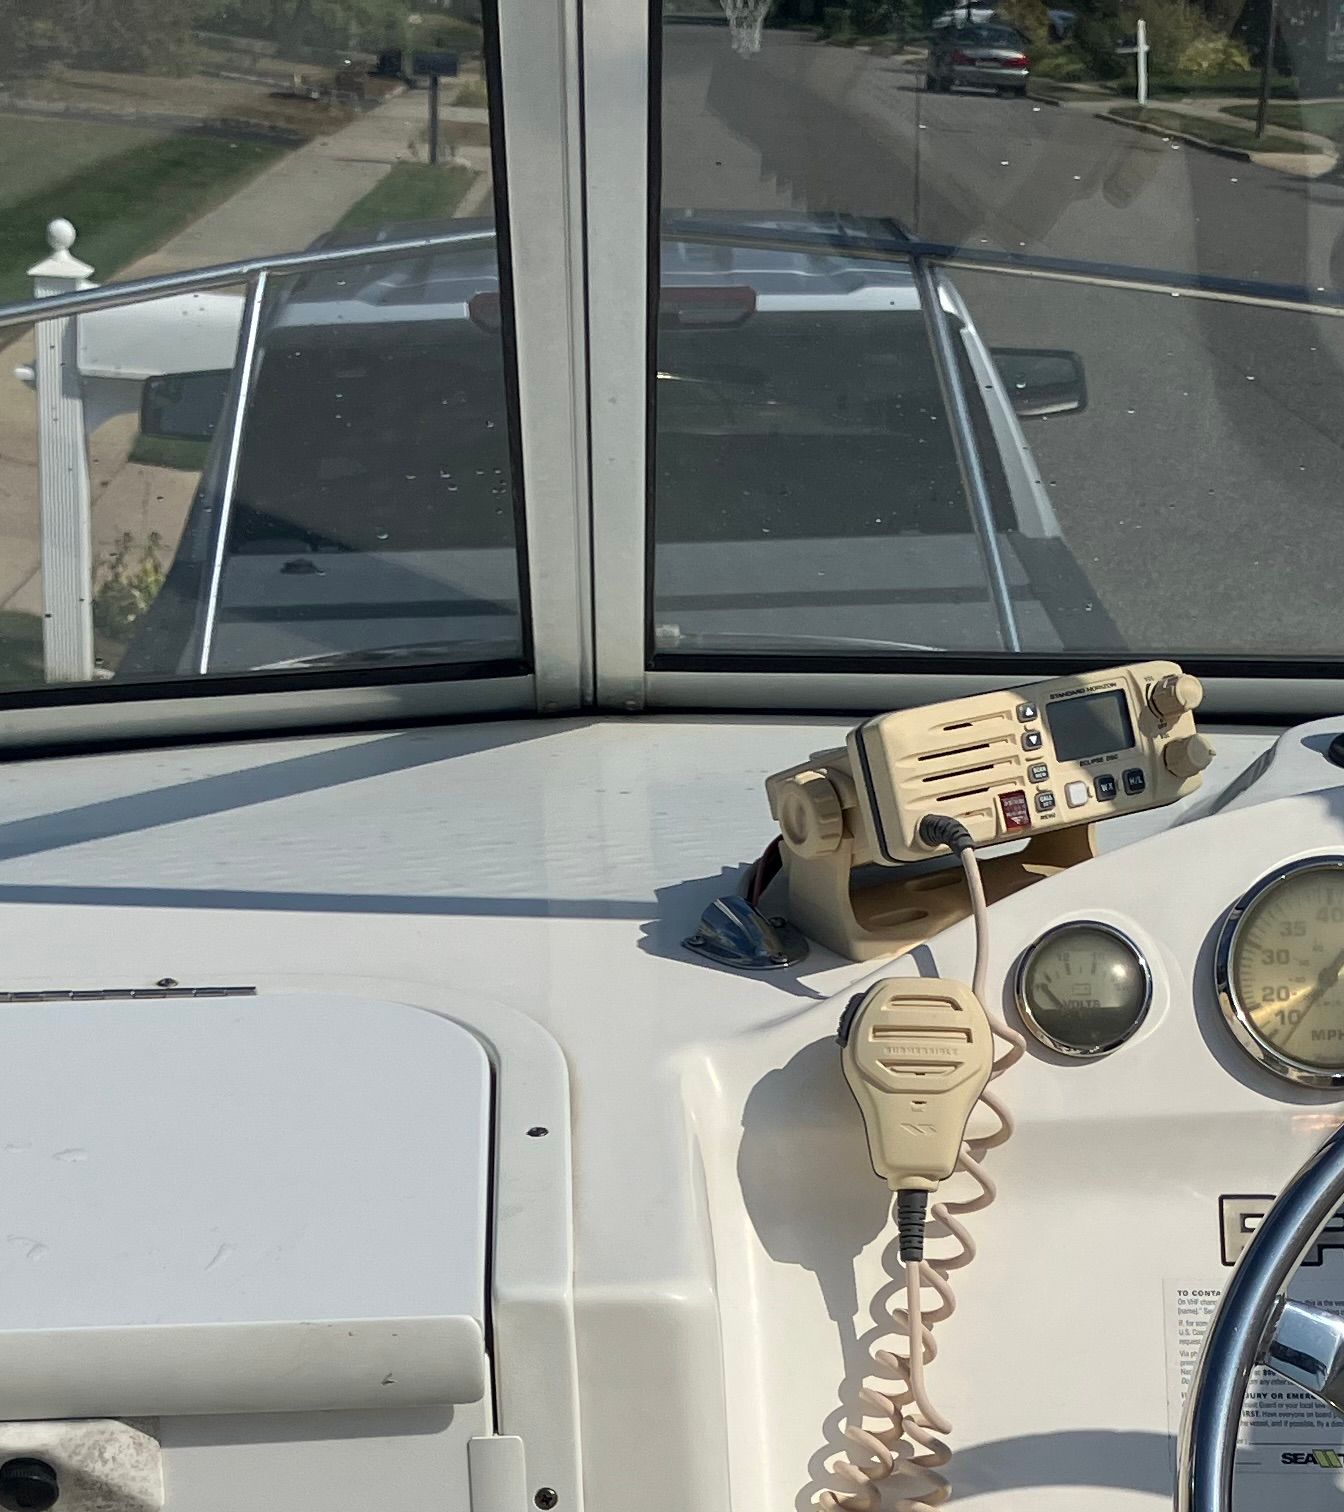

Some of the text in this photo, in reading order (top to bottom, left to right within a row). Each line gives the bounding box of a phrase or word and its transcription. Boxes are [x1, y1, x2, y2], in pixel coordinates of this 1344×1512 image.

[1279, 921, 1308, 938] 35
[1260, 948, 1291, 966] 30
[1261, 985, 1291, 1003] 20
[1274, 1009, 1303, 1026] 10
[1177, 1289, 1189, 1297] TO
[1271, 1392, 1284, 1400] OR
[1281, 1453, 1316, 1465] SEA
